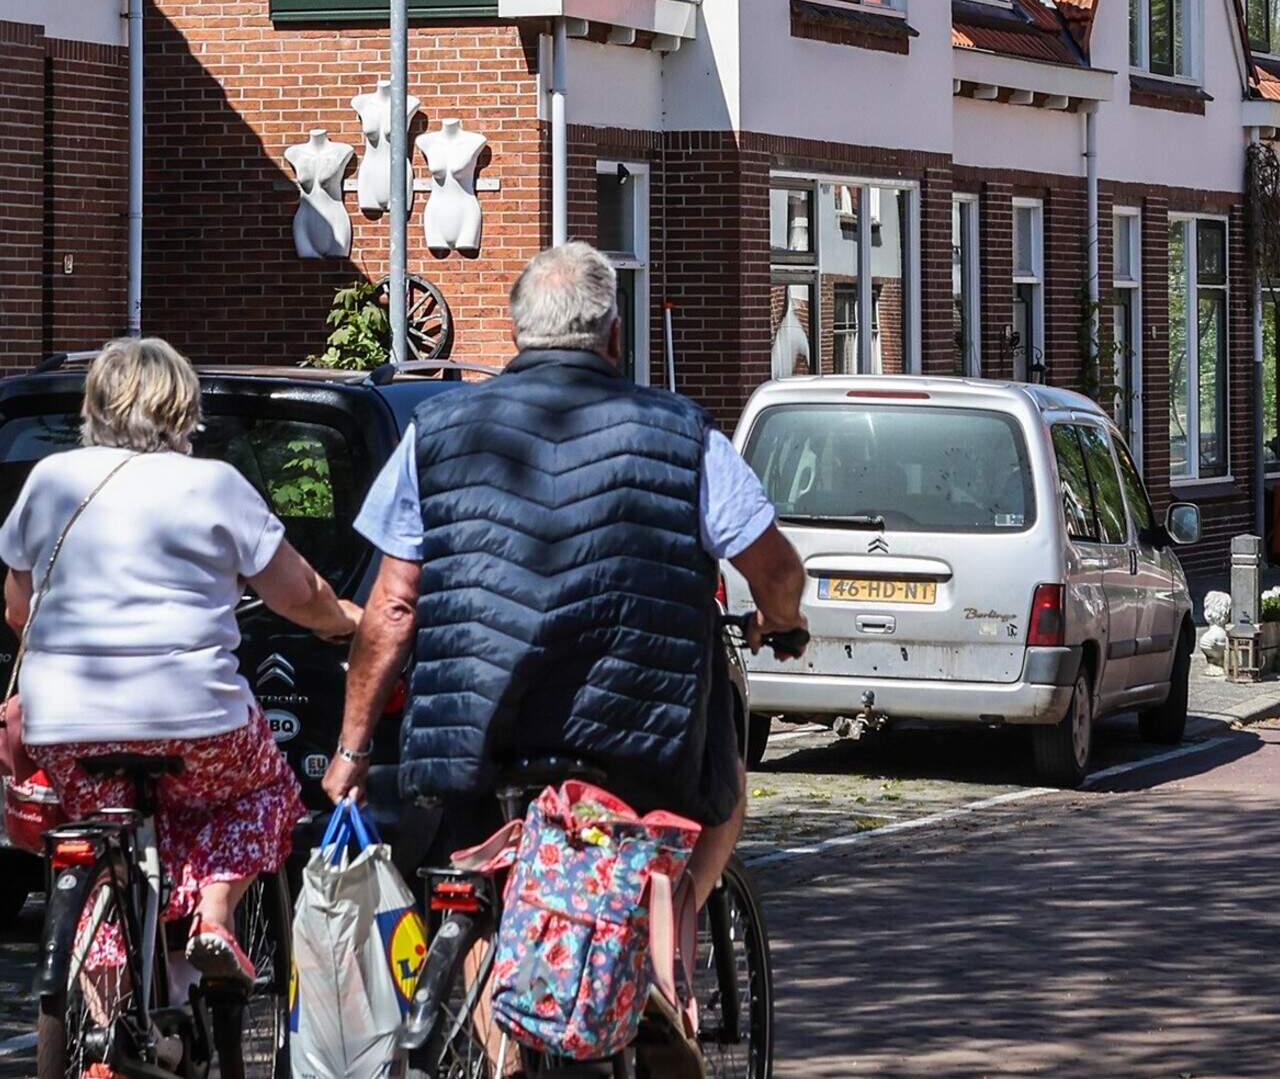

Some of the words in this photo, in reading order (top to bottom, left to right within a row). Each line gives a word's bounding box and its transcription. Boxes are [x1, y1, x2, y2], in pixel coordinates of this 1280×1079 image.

[833, 580, 932, 600] 46-HD-NT
[963, 607, 1017, 623] Berlingo
[269, 719, 294, 734] BQ
